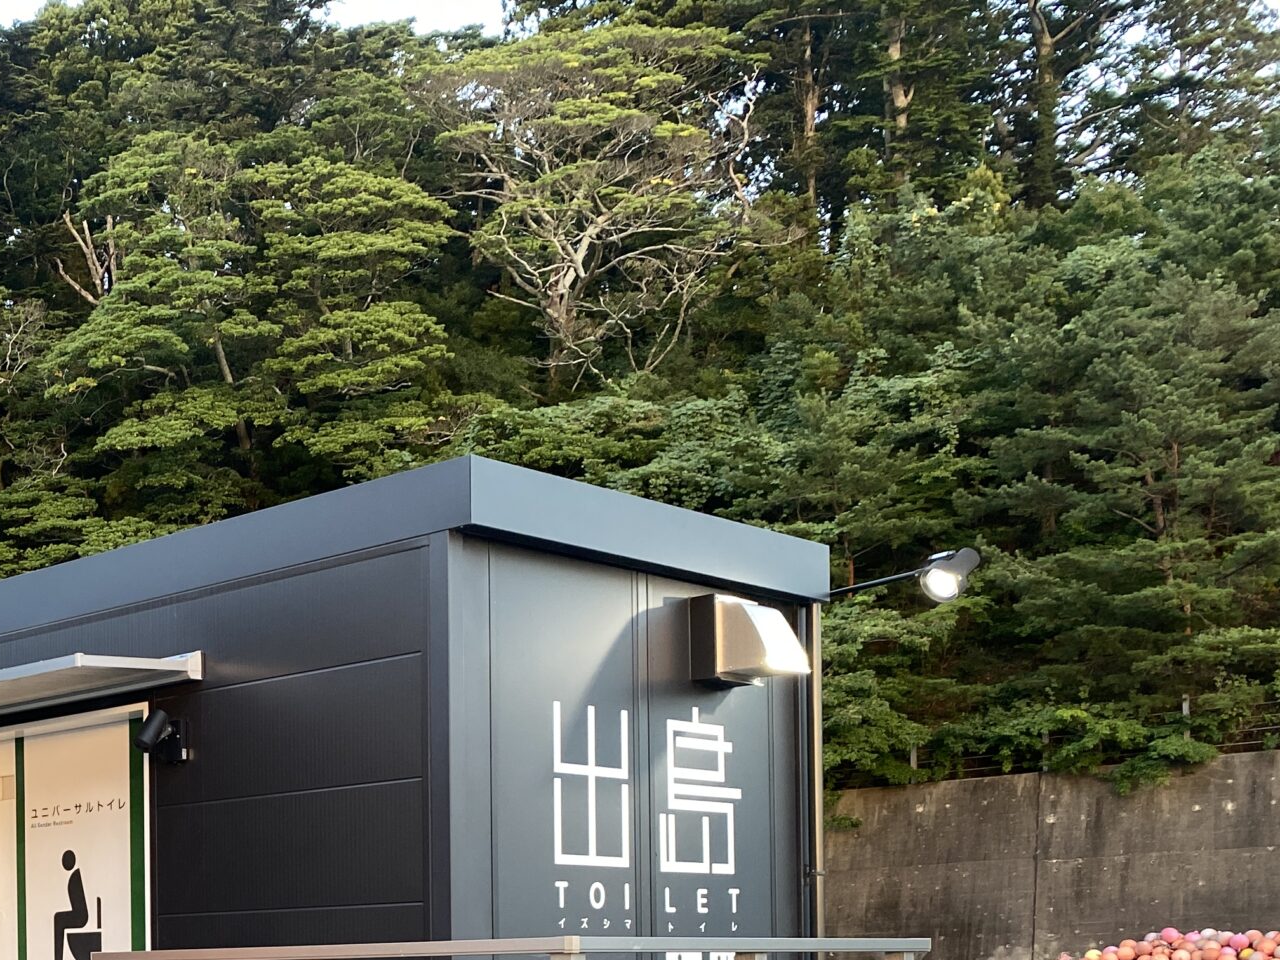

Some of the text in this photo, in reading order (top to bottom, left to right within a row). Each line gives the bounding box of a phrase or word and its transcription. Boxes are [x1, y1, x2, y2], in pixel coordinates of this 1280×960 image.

[31, 798, 126, 819] ユニバーサルトイレ
[554, 881, 741, 914] TOILET
[558, 918, 632, 929] イズシマ
[668, 921, 738, 932] トイレ
